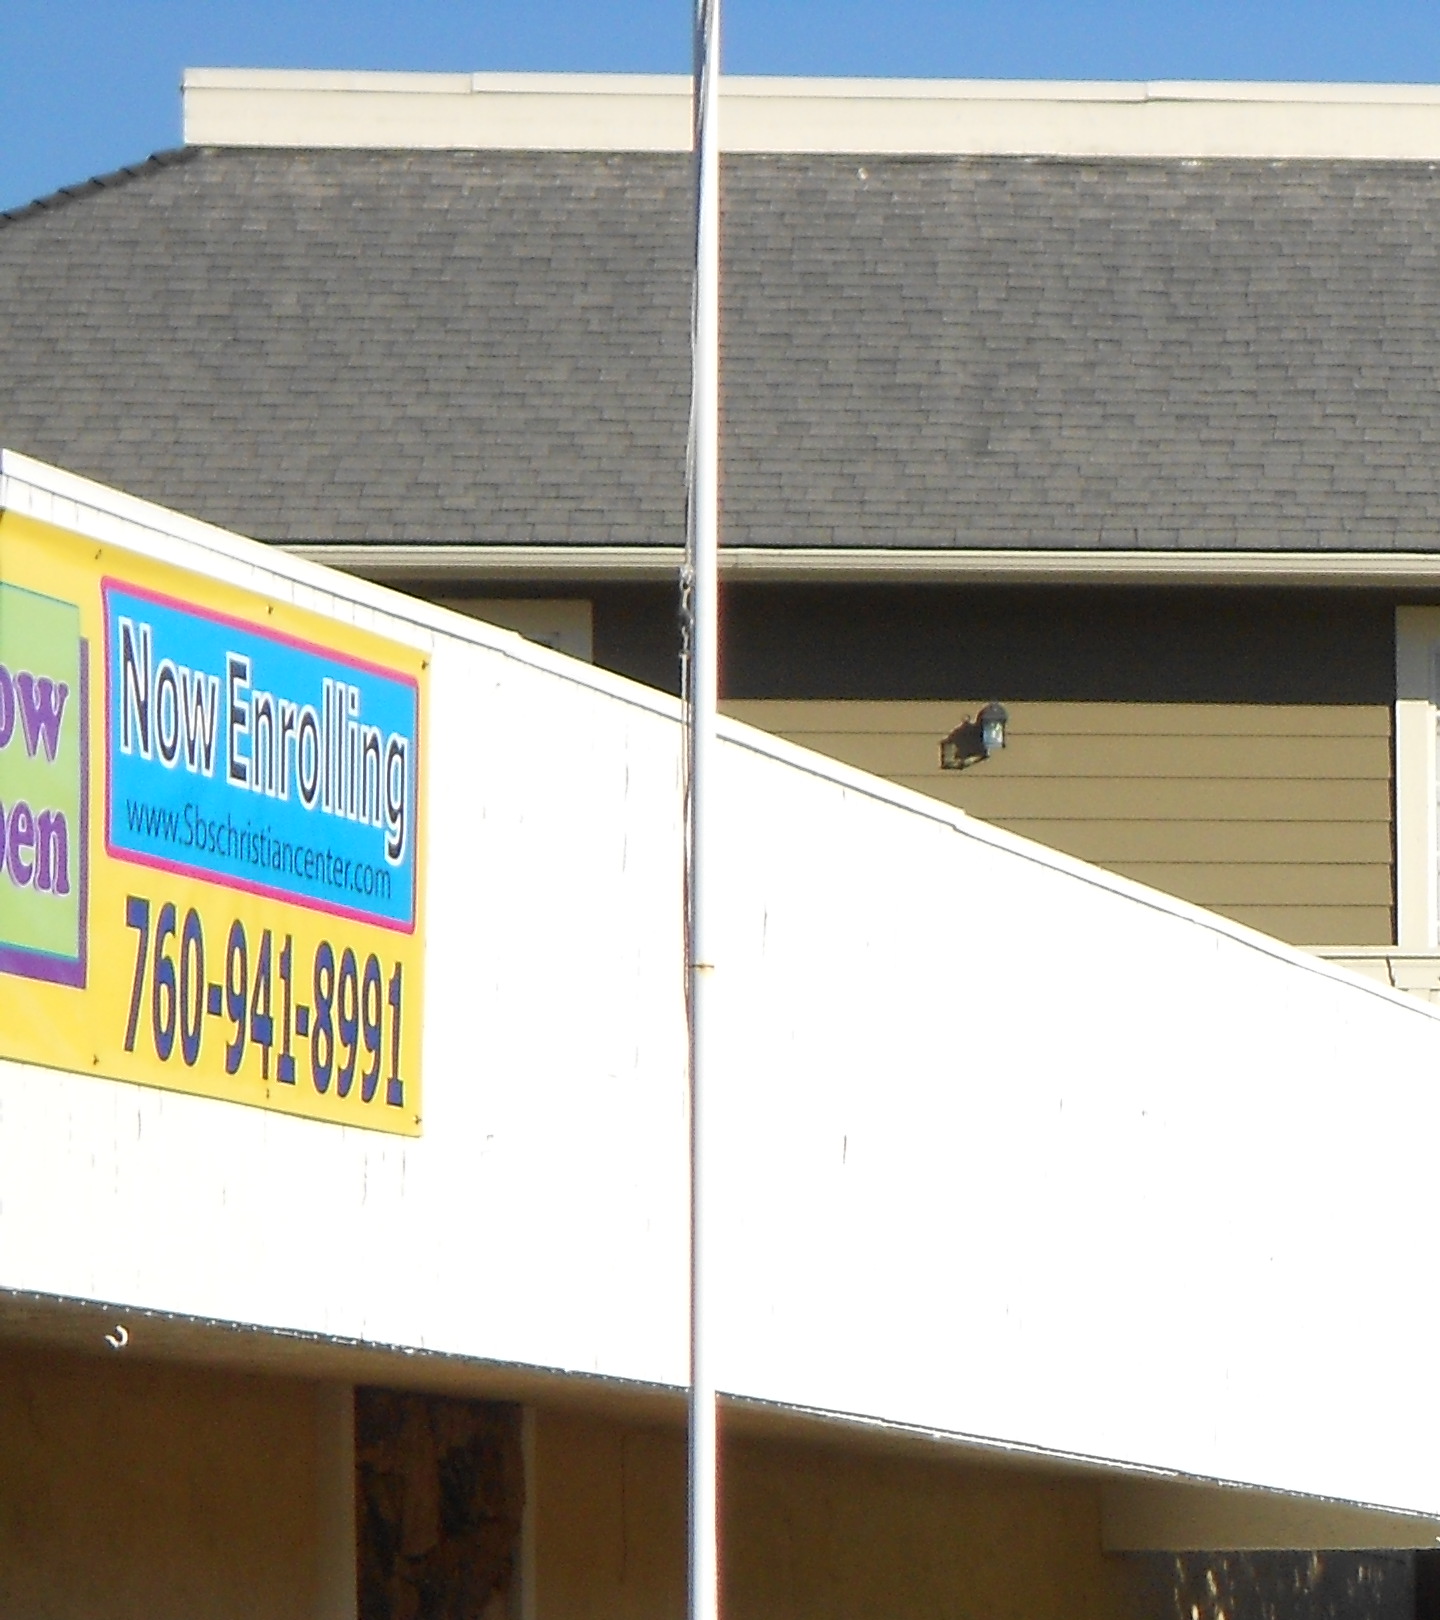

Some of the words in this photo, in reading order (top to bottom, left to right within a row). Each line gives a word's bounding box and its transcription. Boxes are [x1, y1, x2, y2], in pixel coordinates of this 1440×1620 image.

[118, 616, 221, 778] Now
[225, 652, 409, 866] Enrolling
[125, 798, 392, 899] www.Sbschristiancenter.com
[124, 894, 407, 1108] 760-941-8991
